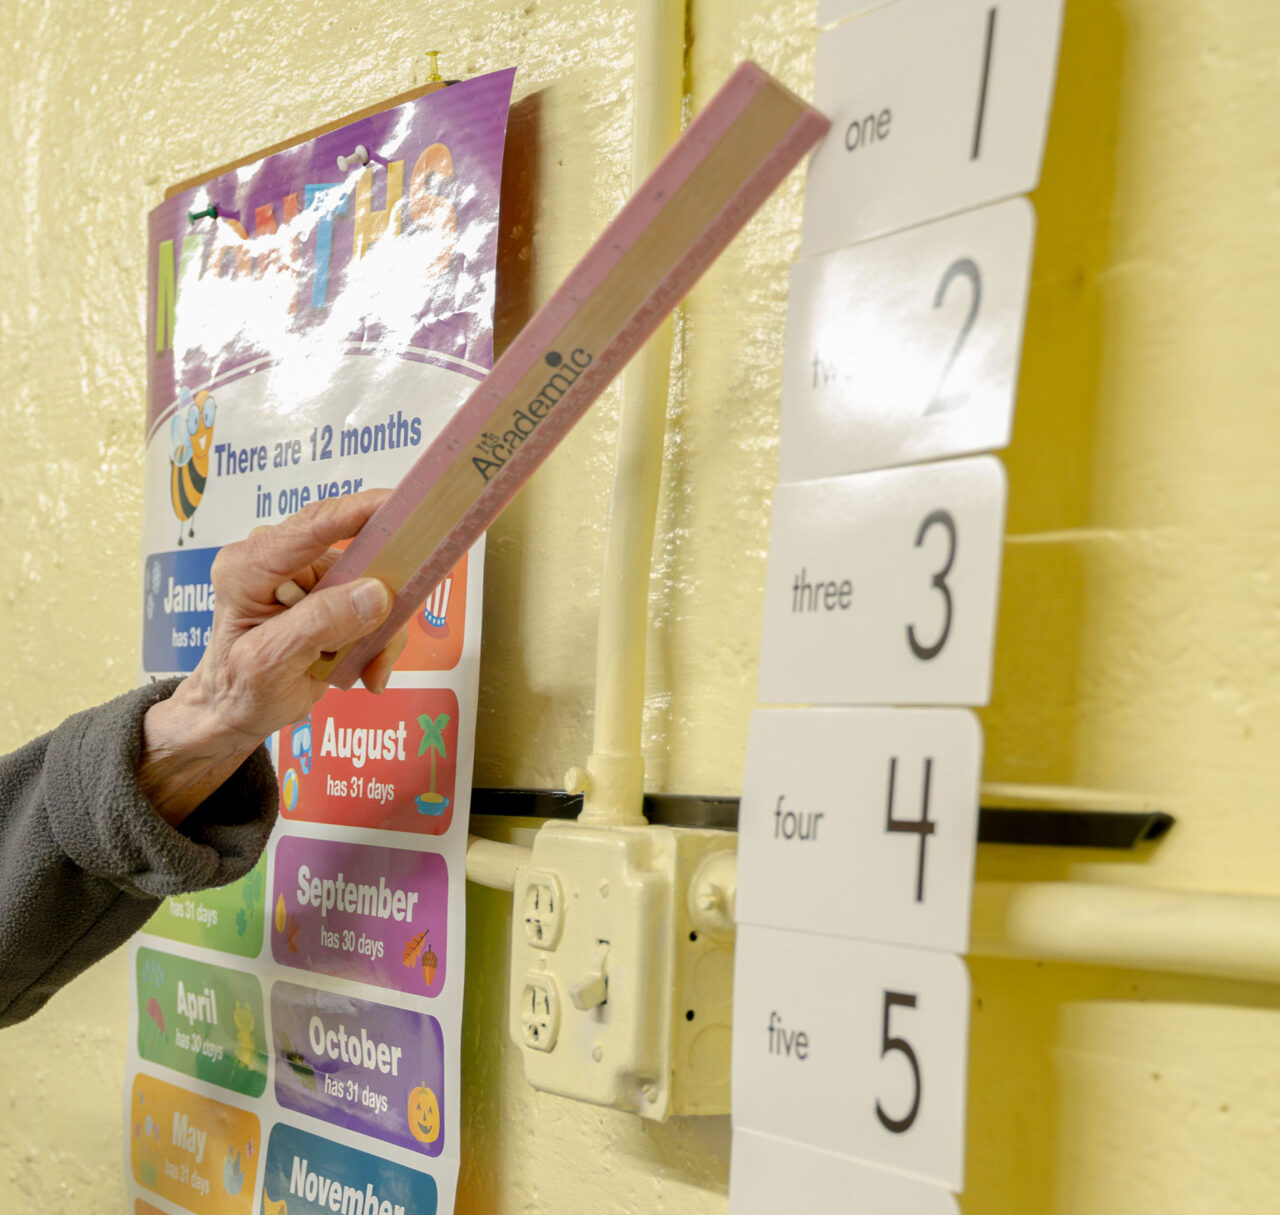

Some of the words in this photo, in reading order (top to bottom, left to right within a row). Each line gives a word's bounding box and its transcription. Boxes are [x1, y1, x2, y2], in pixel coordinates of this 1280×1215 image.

[845, 107, 892, 152] one
[969, 6, 997, 162] 1
[922, 258, 983, 416] 2
[471, 348, 593, 483] Academic
[214, 442, 268, 478] There
[273, 438, 302, 469] are
[309, 424, 334, 461] 12
[339, 410, 422, 458] months
[256, 484, 272, 518] in
[278, 486, 310, 515] one
[163, 576, 216, 615] Janua
[791, 567, 853, 613] three
[905, 508, 958, 661] 3
[172, 627, 188, 648] has
[189, 626, 201, 648] 31
[320, 717, 408, 769] August
[326, 774, 348, 798] has
[350, 776, 364, 799] 31
[367, 777, 395, 806] days
[773, 795, 825, 843] four
[885, 757, 937, 904] 4
[170, 896, 184, 918] has
[185, 900, 195, 921] 31
[197, 903, 218, 928] days
[297, 863, 419, 923] September
[320, 925, 340, 950] has
[342, 929, 356, 953] 30
[357, 932, 385, 961] days
[177, 980, 218, 1026] April
[175, 1027, 190, 1050] has
[191, 1033, 202, 1054] 30
[202, 1038, 224, 1063] days
[309, 1015, 403, 1077] October
[767, 1011, 810, 1061] five
[874, 989, 922, 1134] 5
[324, 1073, 344, 1098] has
[345, 1081, 360, 1104] 31
[362, 1086, 389, 1114] days
[172, 1111, 207, 1164] May
[191, 1169, 210, 1197] days
